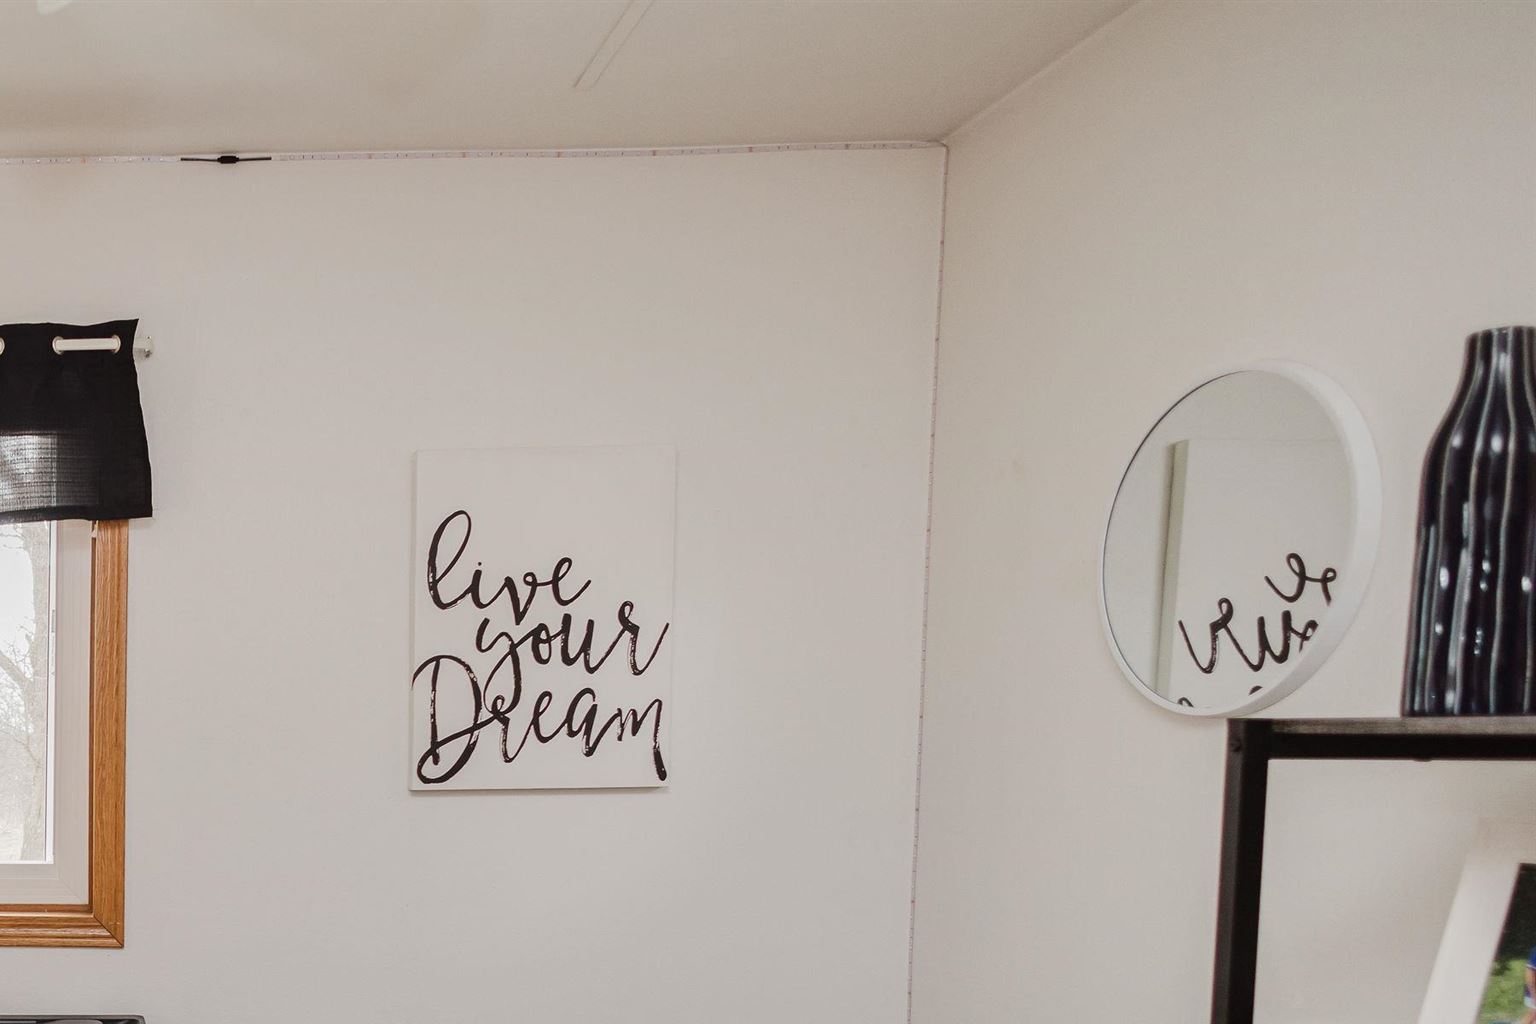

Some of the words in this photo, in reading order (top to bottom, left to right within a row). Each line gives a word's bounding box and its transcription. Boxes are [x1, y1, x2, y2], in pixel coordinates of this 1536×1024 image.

[427, 509, 592, 626] live
[475, 600, 670, 716] your
[411, 654, 668, 785] Dream
